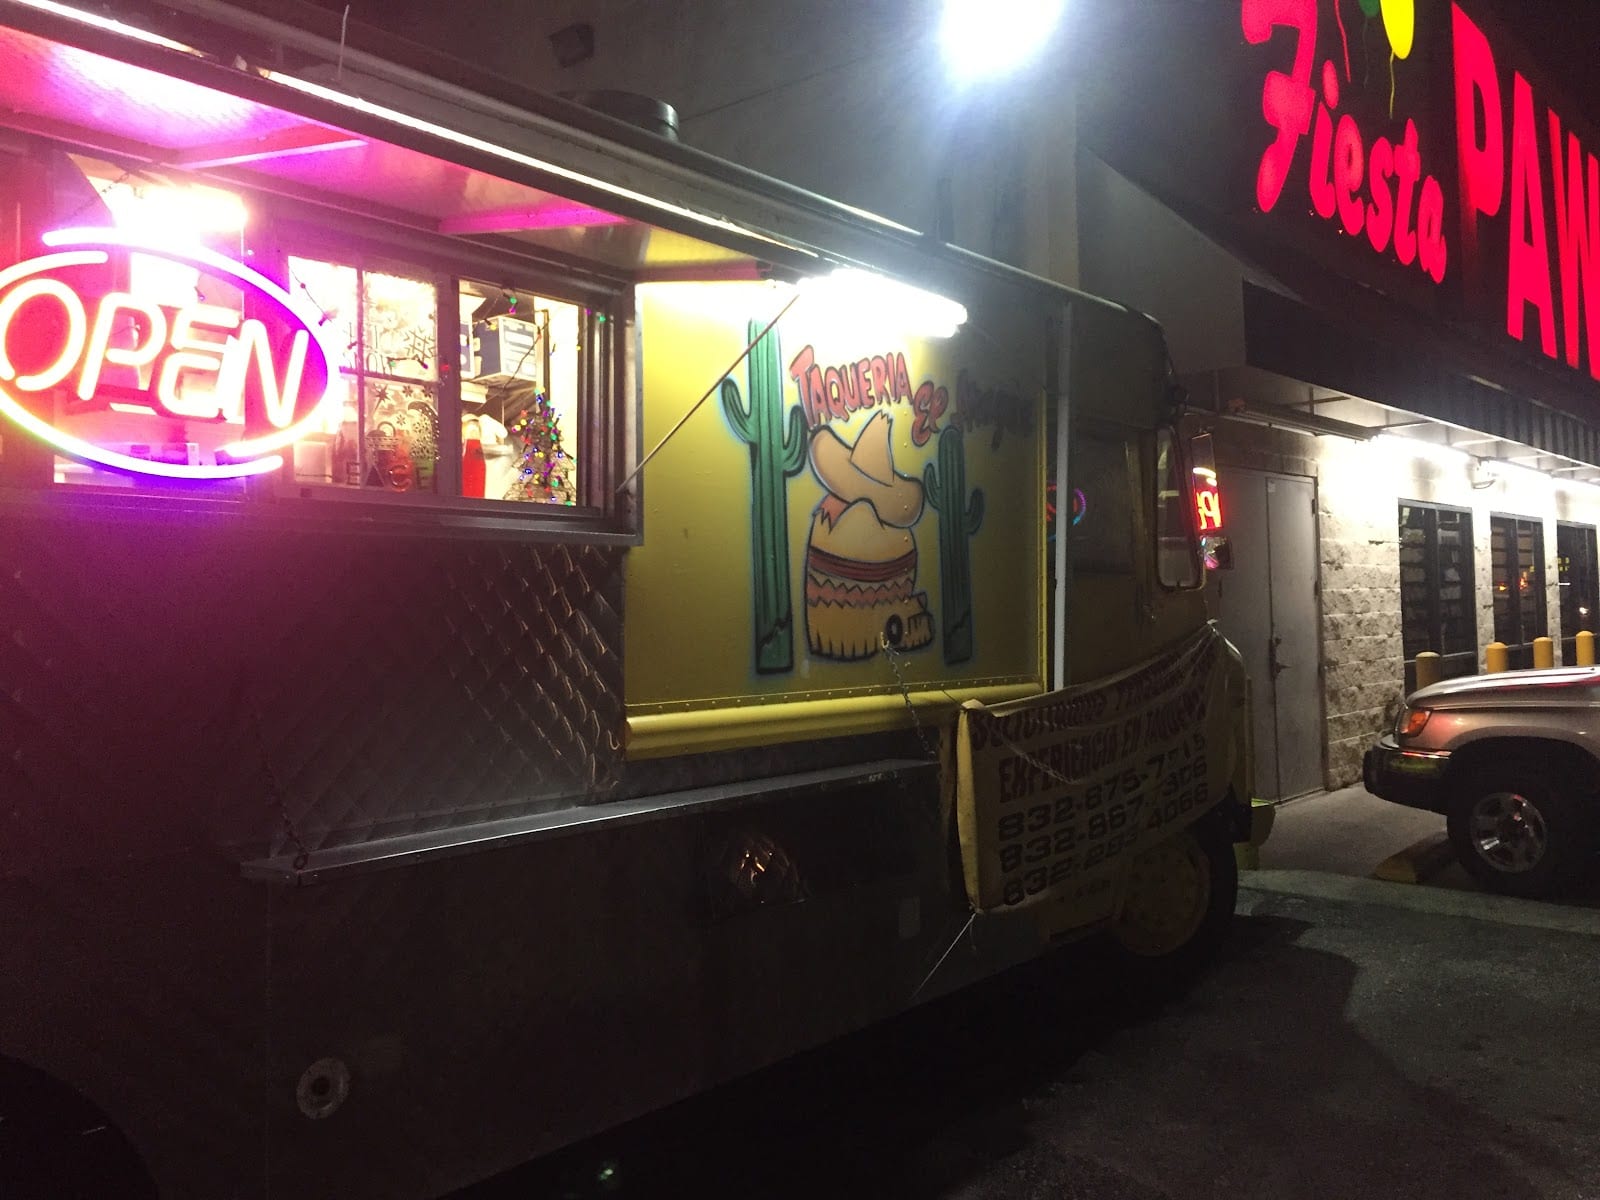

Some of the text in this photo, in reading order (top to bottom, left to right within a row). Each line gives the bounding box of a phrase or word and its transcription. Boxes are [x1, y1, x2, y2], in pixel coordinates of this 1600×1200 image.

[1242, 0, 1447, 284] Fiesta
[0, 278, 309, 428] OPEN
[790, 345, 914, 430] TAQUERIA
